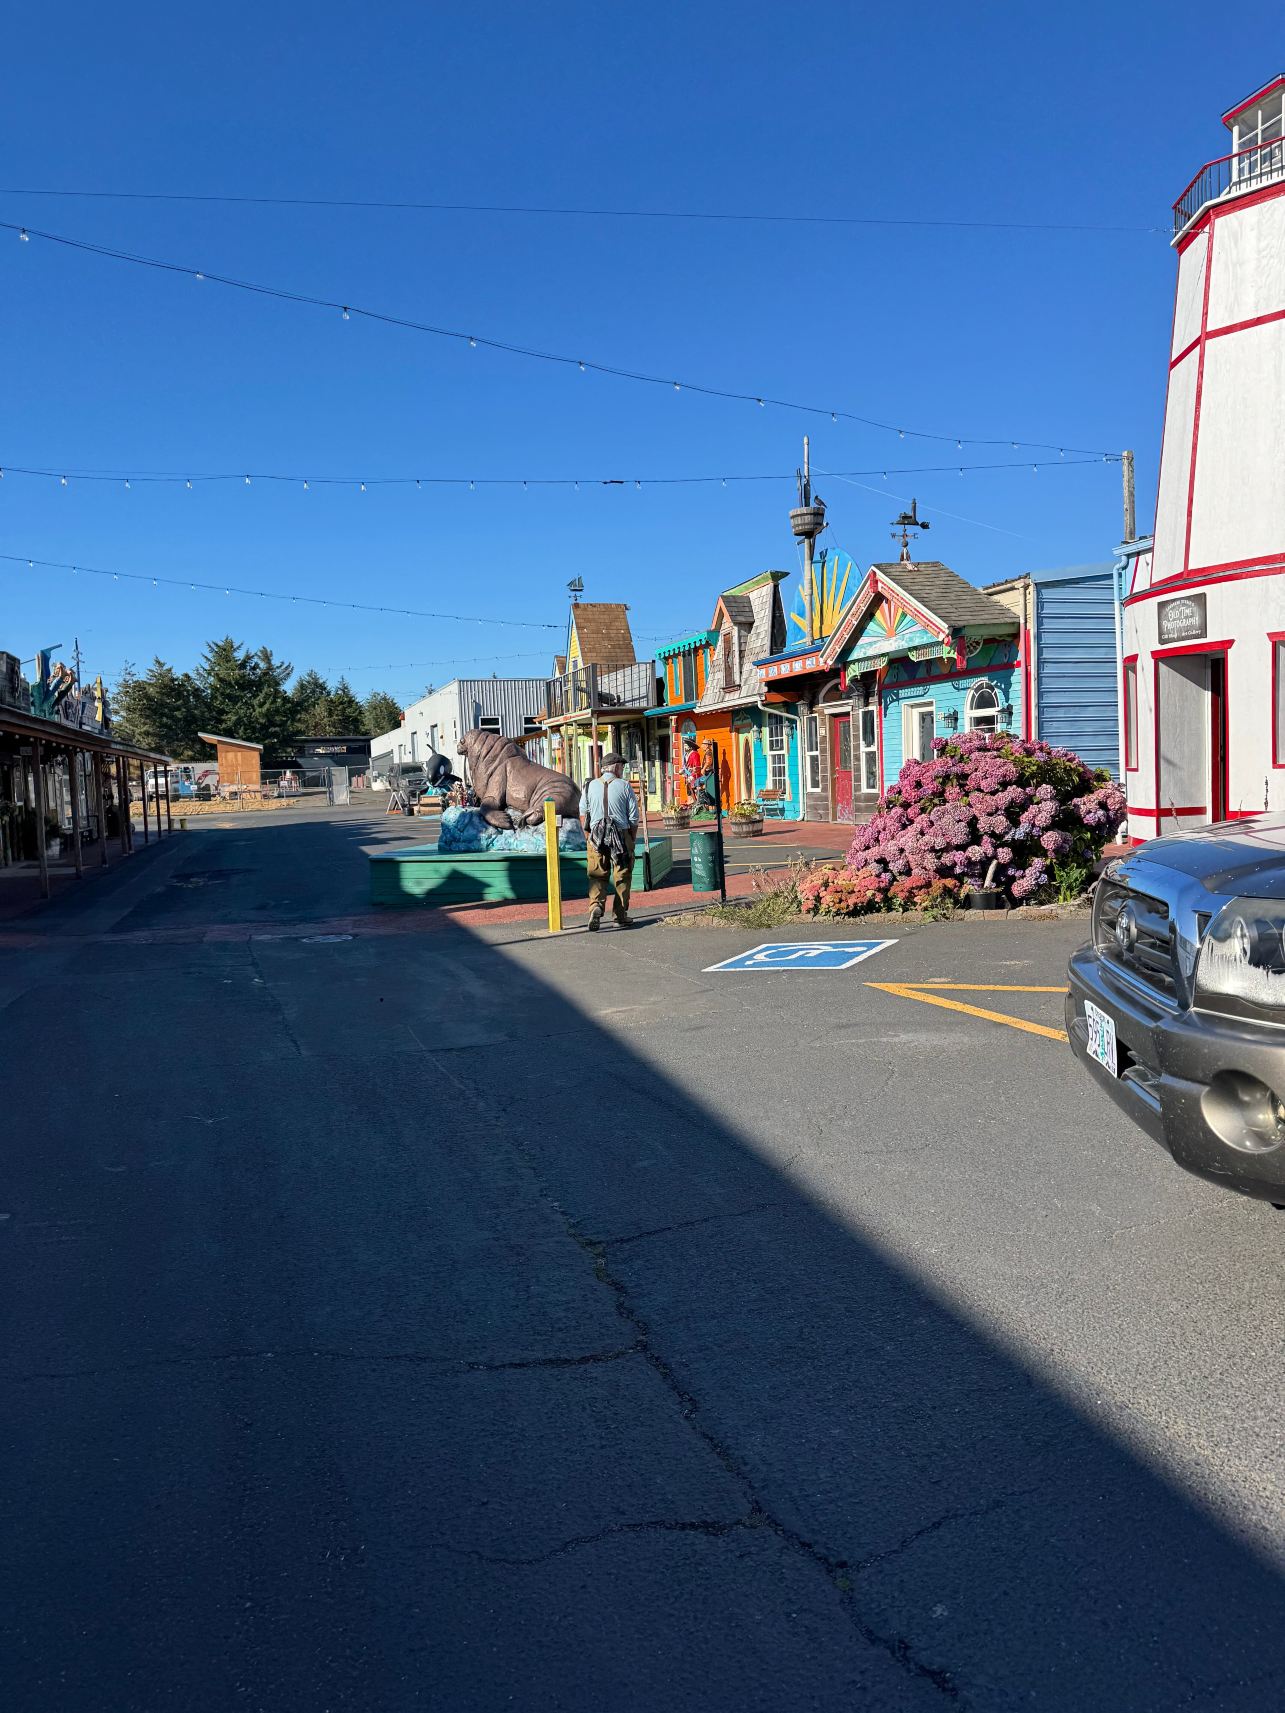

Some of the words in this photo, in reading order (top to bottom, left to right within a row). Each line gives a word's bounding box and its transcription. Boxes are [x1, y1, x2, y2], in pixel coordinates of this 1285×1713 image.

[1168, 610, 1179, 621] OLD
[1179, 607, 1192, 619] TIME
[1162, 616, 1198, 632] PHOTOGRAPHY
